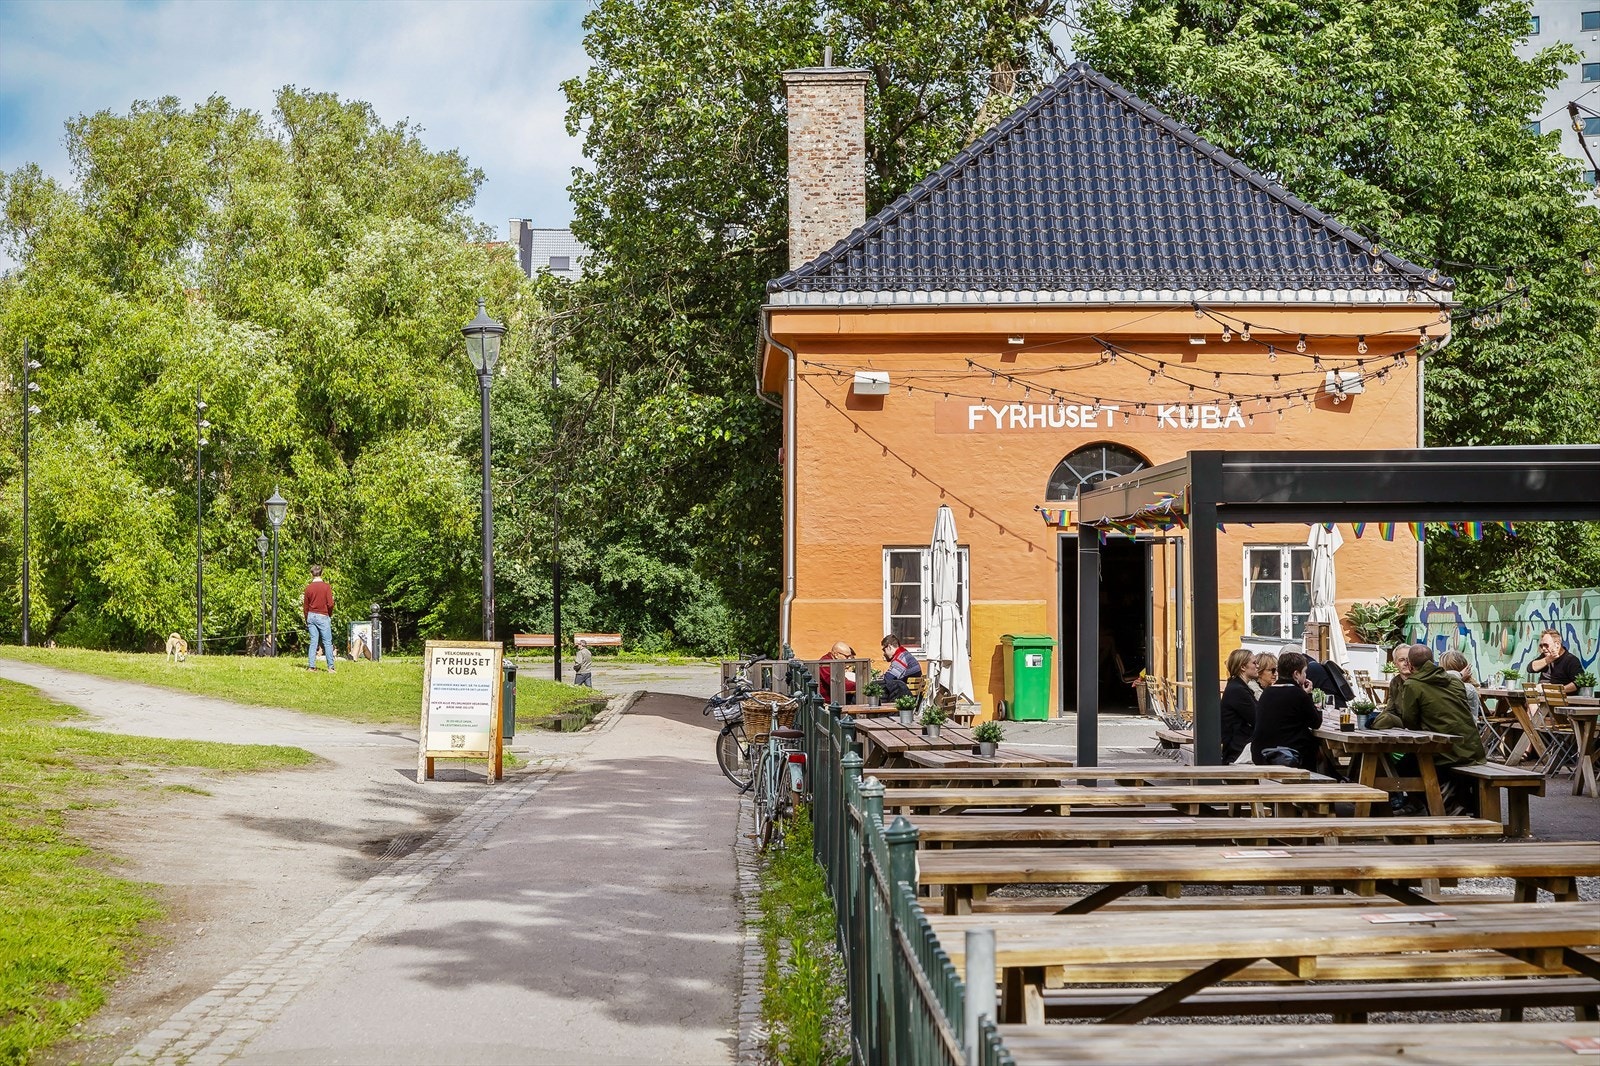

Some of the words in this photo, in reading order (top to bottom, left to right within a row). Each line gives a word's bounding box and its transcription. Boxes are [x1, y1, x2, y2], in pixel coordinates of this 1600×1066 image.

[968, 404, 1120, 430] FYRHUSET
[1157, 404, 1247, 430] KUBA
[435, 657, 491, 666] FYRHUSET
[447, 667, 478, 676] KUBA
